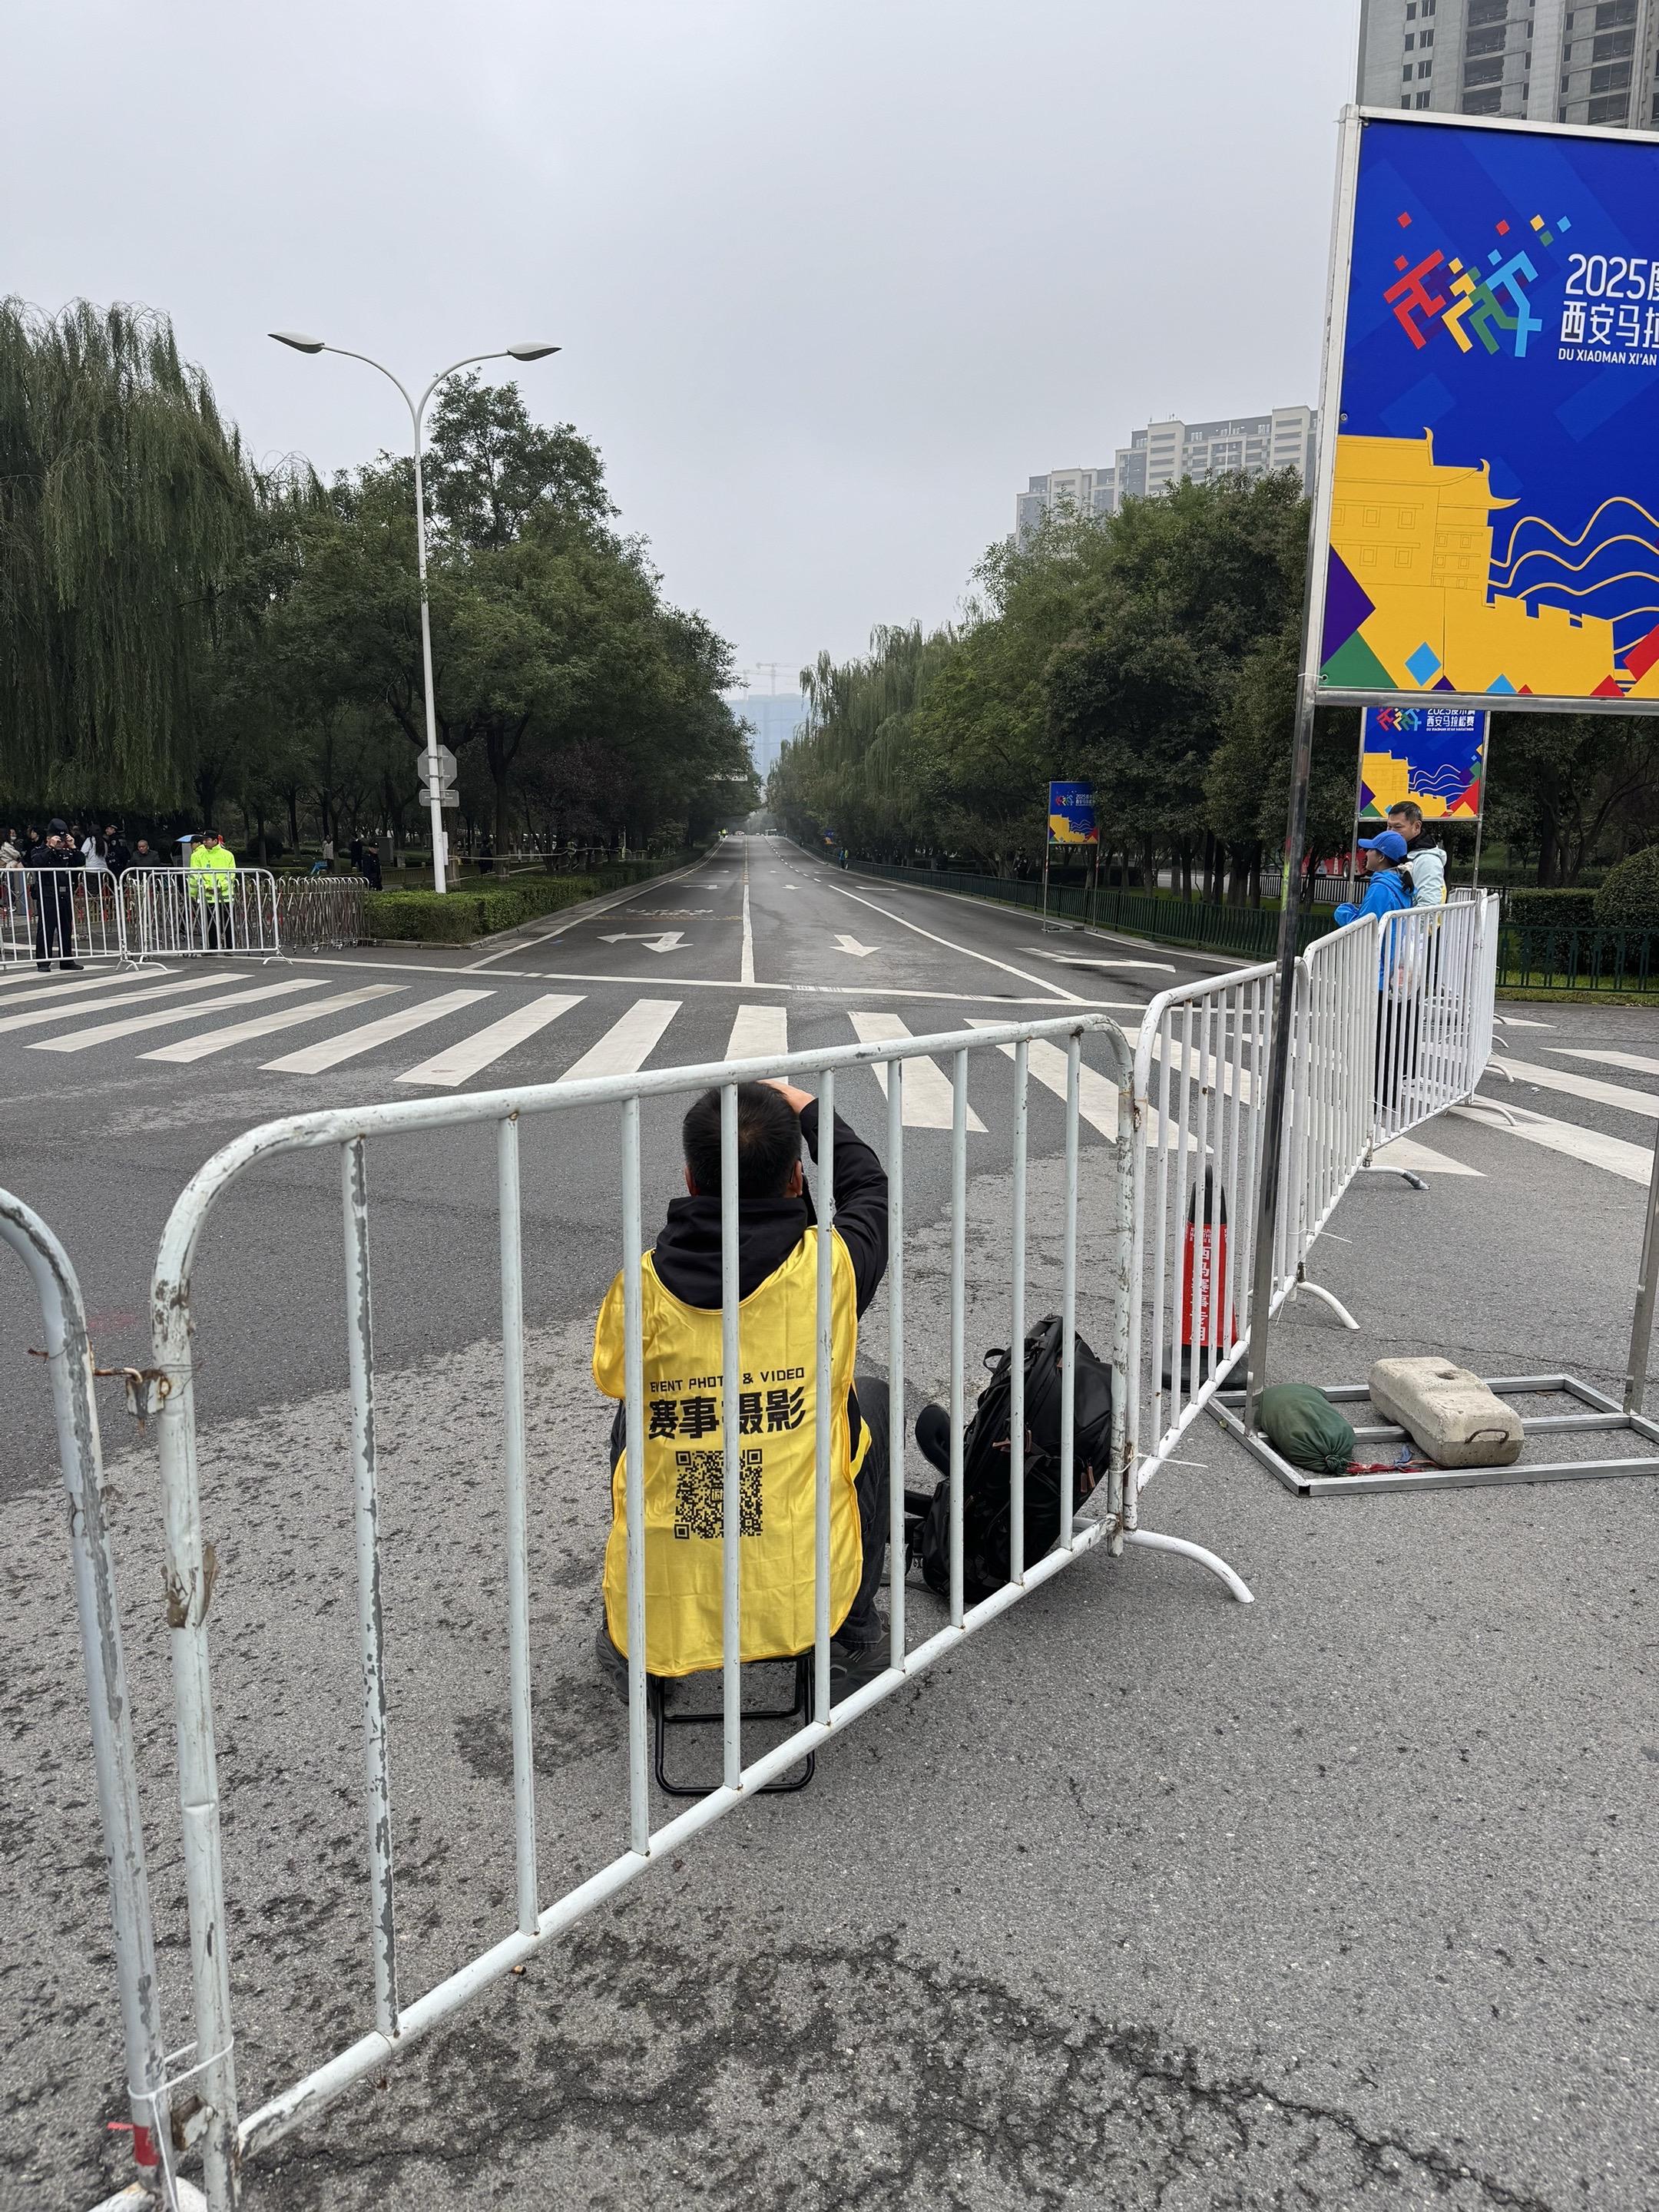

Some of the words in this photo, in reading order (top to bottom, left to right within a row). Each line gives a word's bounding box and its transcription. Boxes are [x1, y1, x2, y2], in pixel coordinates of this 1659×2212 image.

[1558, 347, 1575, 361] DU
[1576, 349, 1626, 364] XIAOMAN
[1628, 352, 1657, 366] XI'AN
[1426, 716, 1475, 727] 西安马拉松赛
[651, 1379, 683, 1392] EVENT
[688, 1376, 724, 1390] PHOT
[743, 1373, 753, 1384] &
[760, 1367, 805, 1382] VIDEO
